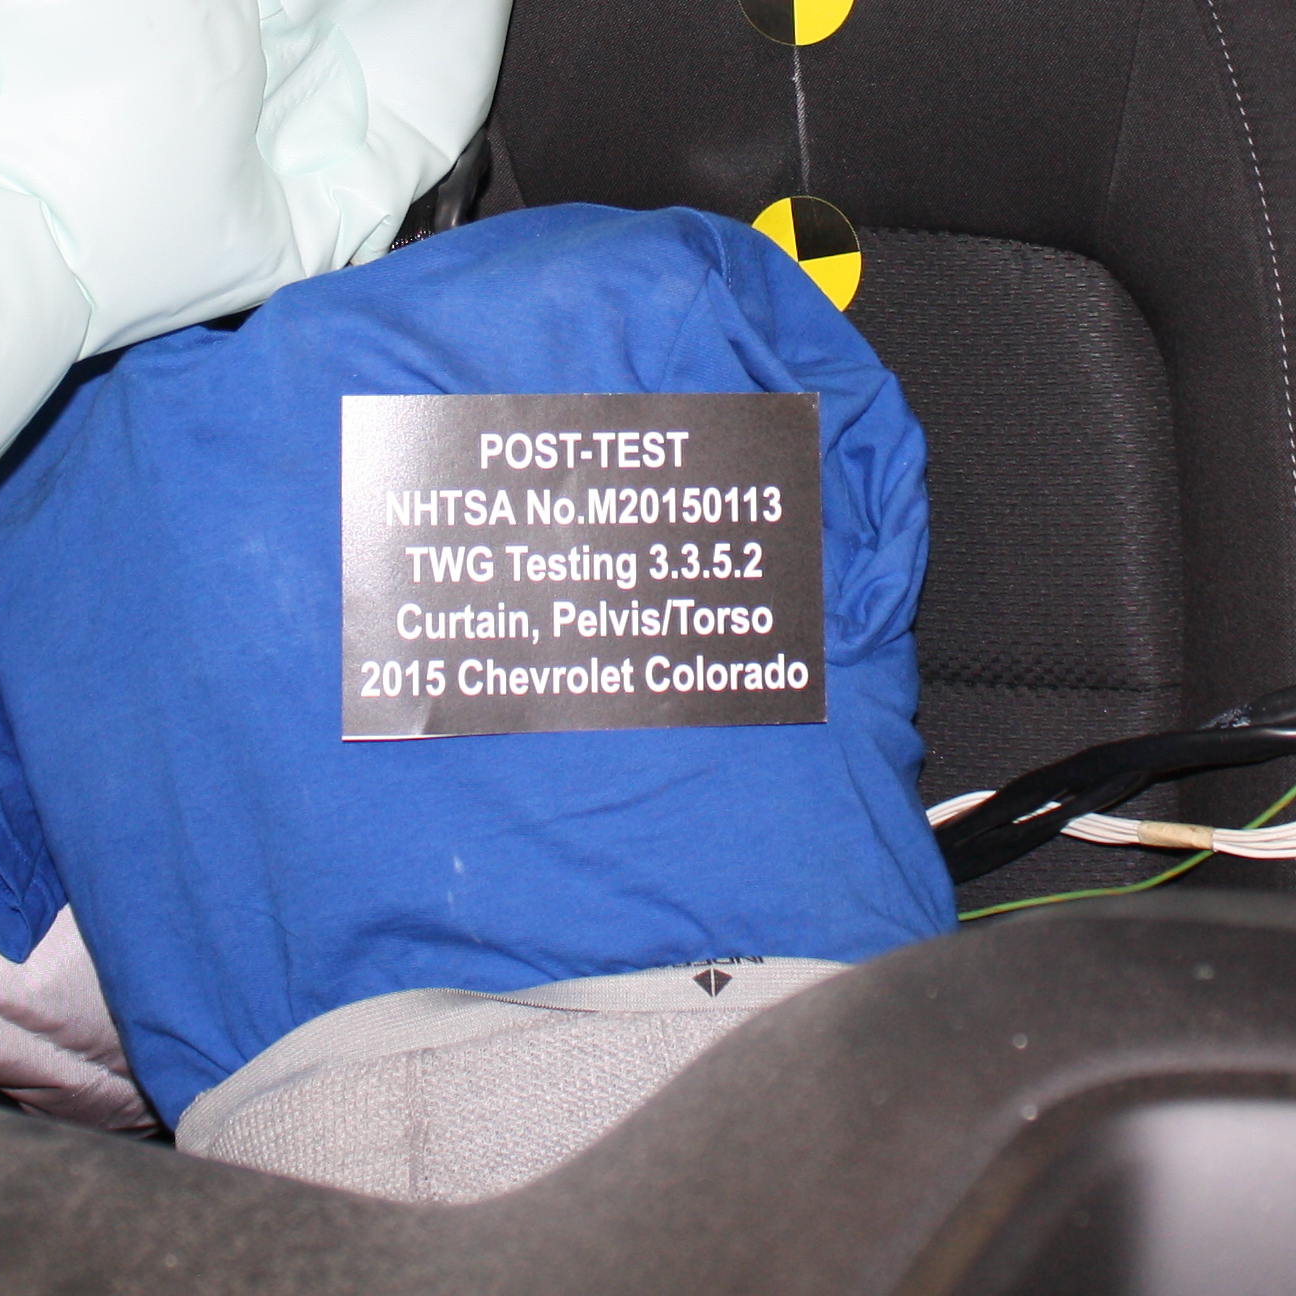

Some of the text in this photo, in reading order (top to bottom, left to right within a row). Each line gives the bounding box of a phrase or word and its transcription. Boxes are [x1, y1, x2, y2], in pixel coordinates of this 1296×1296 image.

[479, 431, 690, 470] POST-TEST
[386, 486, 783, 527] NHTSA No.M20150113
[405, 541, 764, 590] TWG Testing 3.3.5.2
[395, 598, 774, 645] Curtain, Pelvis/Torso
[360, 652, 810, 698] 2015 Chevrolet Colorado
